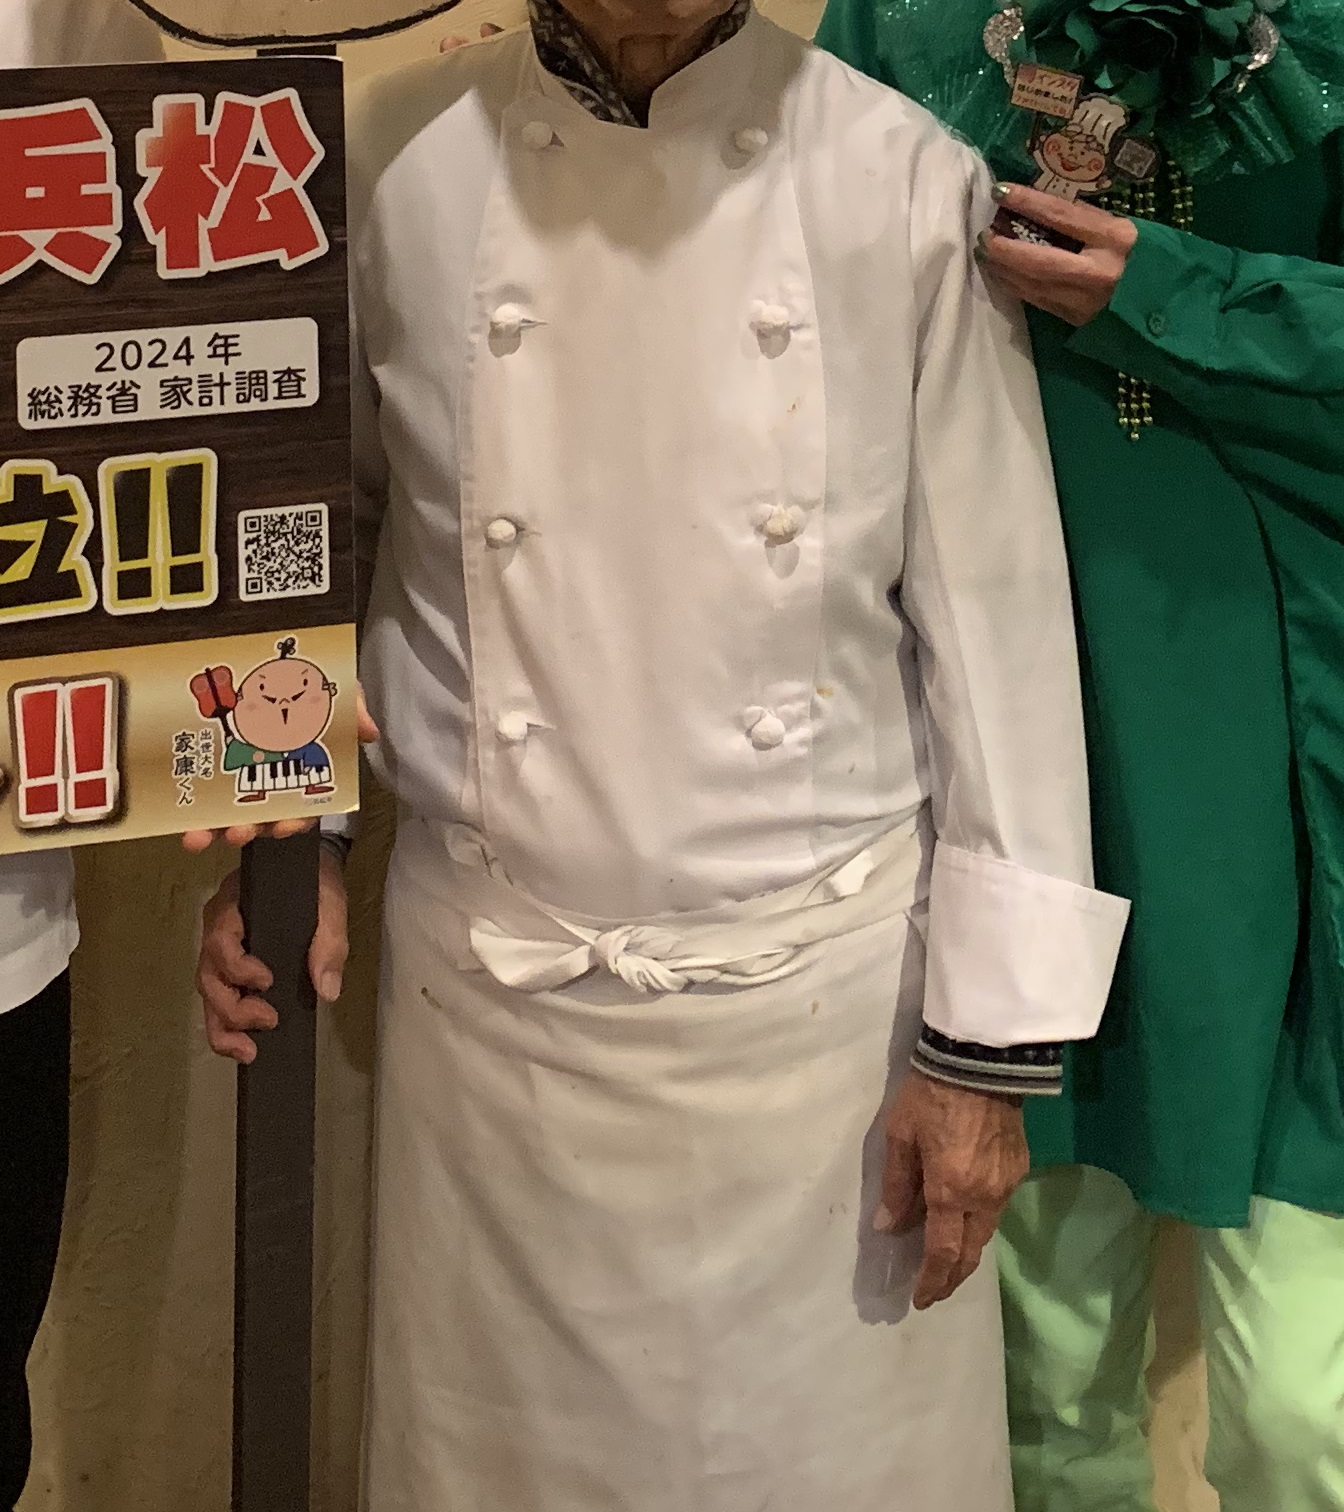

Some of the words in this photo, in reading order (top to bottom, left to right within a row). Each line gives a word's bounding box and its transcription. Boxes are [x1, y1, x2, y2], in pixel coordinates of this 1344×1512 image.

[27, 380, 142, 422] 総務省
[158, 366, 308, 411] 家計調査
[173, 731, 196, 806] 家康くん
[199, 729, 214, 779] 出世大名
